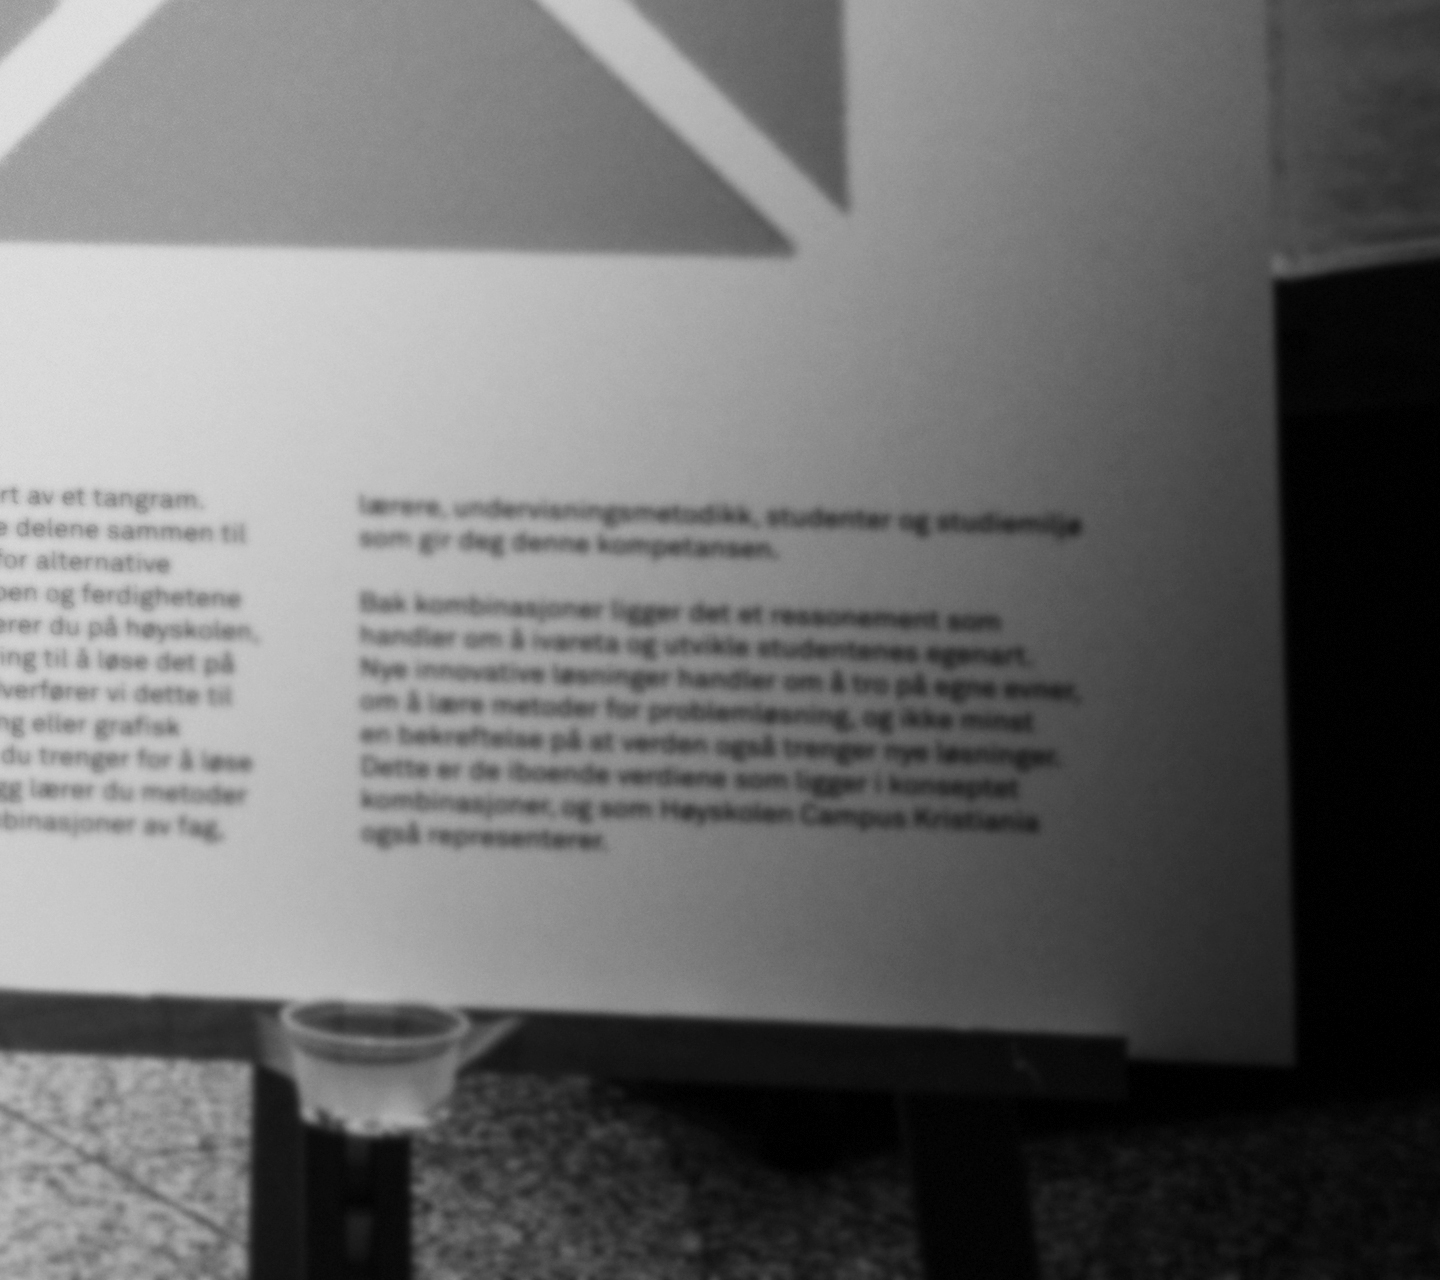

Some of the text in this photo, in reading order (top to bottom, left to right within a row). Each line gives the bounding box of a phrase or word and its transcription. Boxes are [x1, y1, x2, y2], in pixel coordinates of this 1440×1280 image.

[26, 487, 55, 506] av
[60, 482, 87, 507] et
[14, 512, 101, 539] delene
[106, 522, 217, 543] sammen
[216, 519, 248, 544] til
[35, 546, 172, 575] alternative
